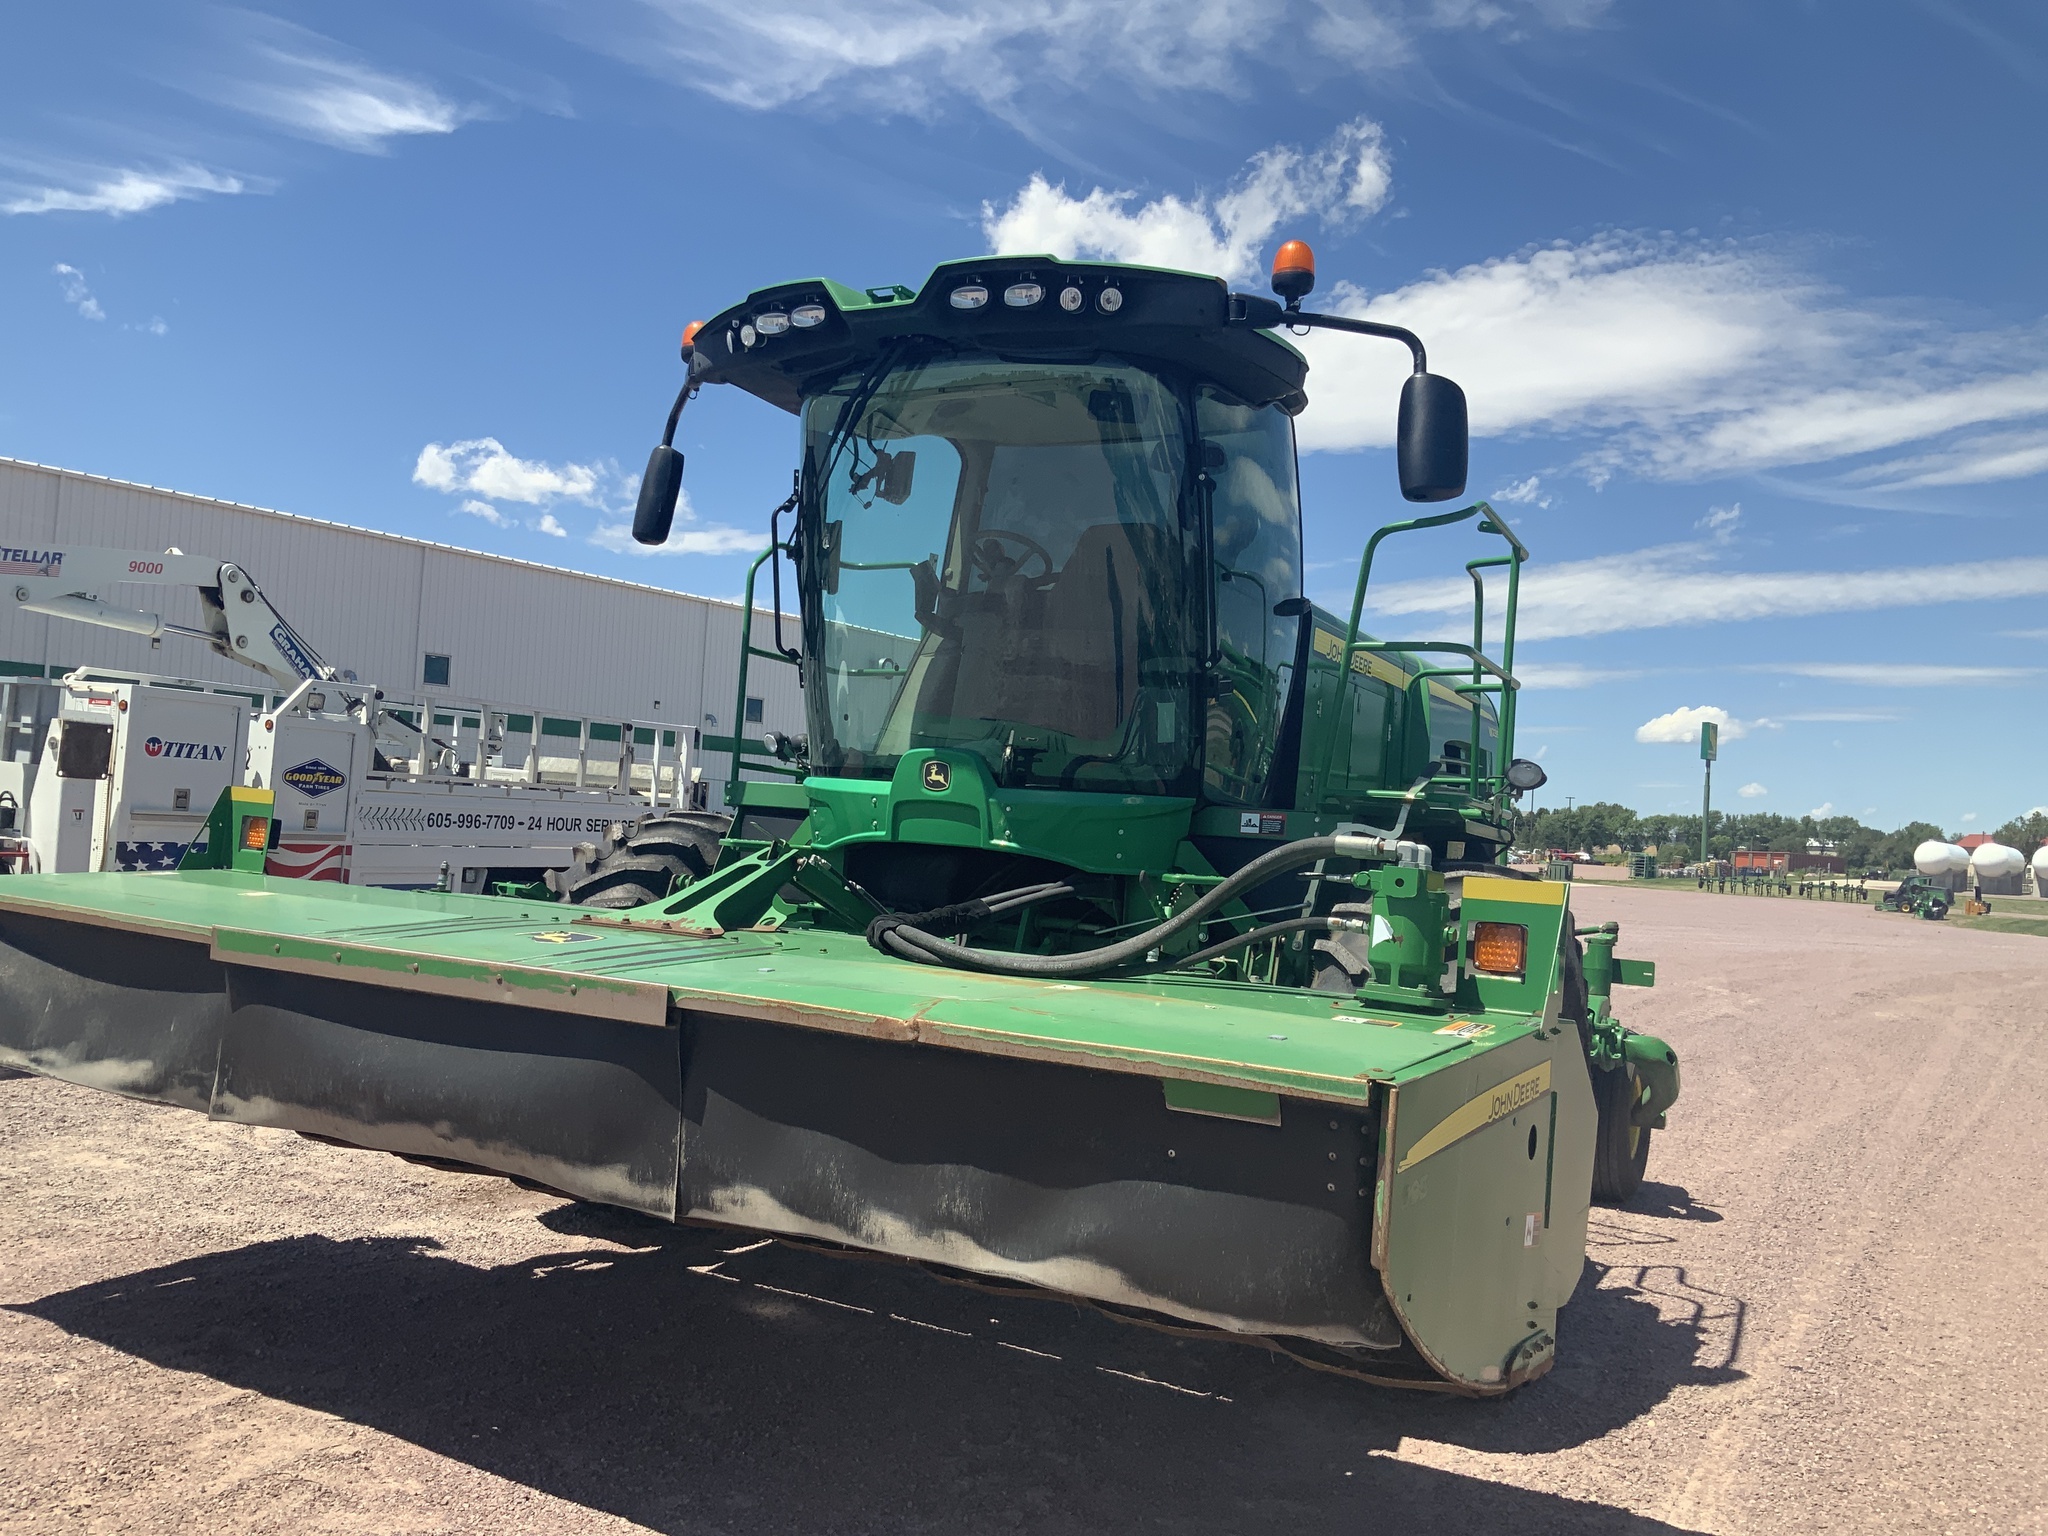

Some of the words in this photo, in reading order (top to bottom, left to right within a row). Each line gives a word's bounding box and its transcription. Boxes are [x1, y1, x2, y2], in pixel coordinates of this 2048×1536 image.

[0, 545, 63, 565] TELLAR
[128, 560, 163, 574] 9000
[1326, 639, 1344, 661] JOH
[162, 740, 228, 761] TITAN
[285, 772, 343, 784] GOODYEAR
[427, 812, 515, 830] 605-996-7709
[527, 816, 542, 831] 24
[546, 816, 582, 832] HOUR
[1488, 1089, 1514, 1120] JOHN
[1513, 1076, 1540, 1108] DEERE
